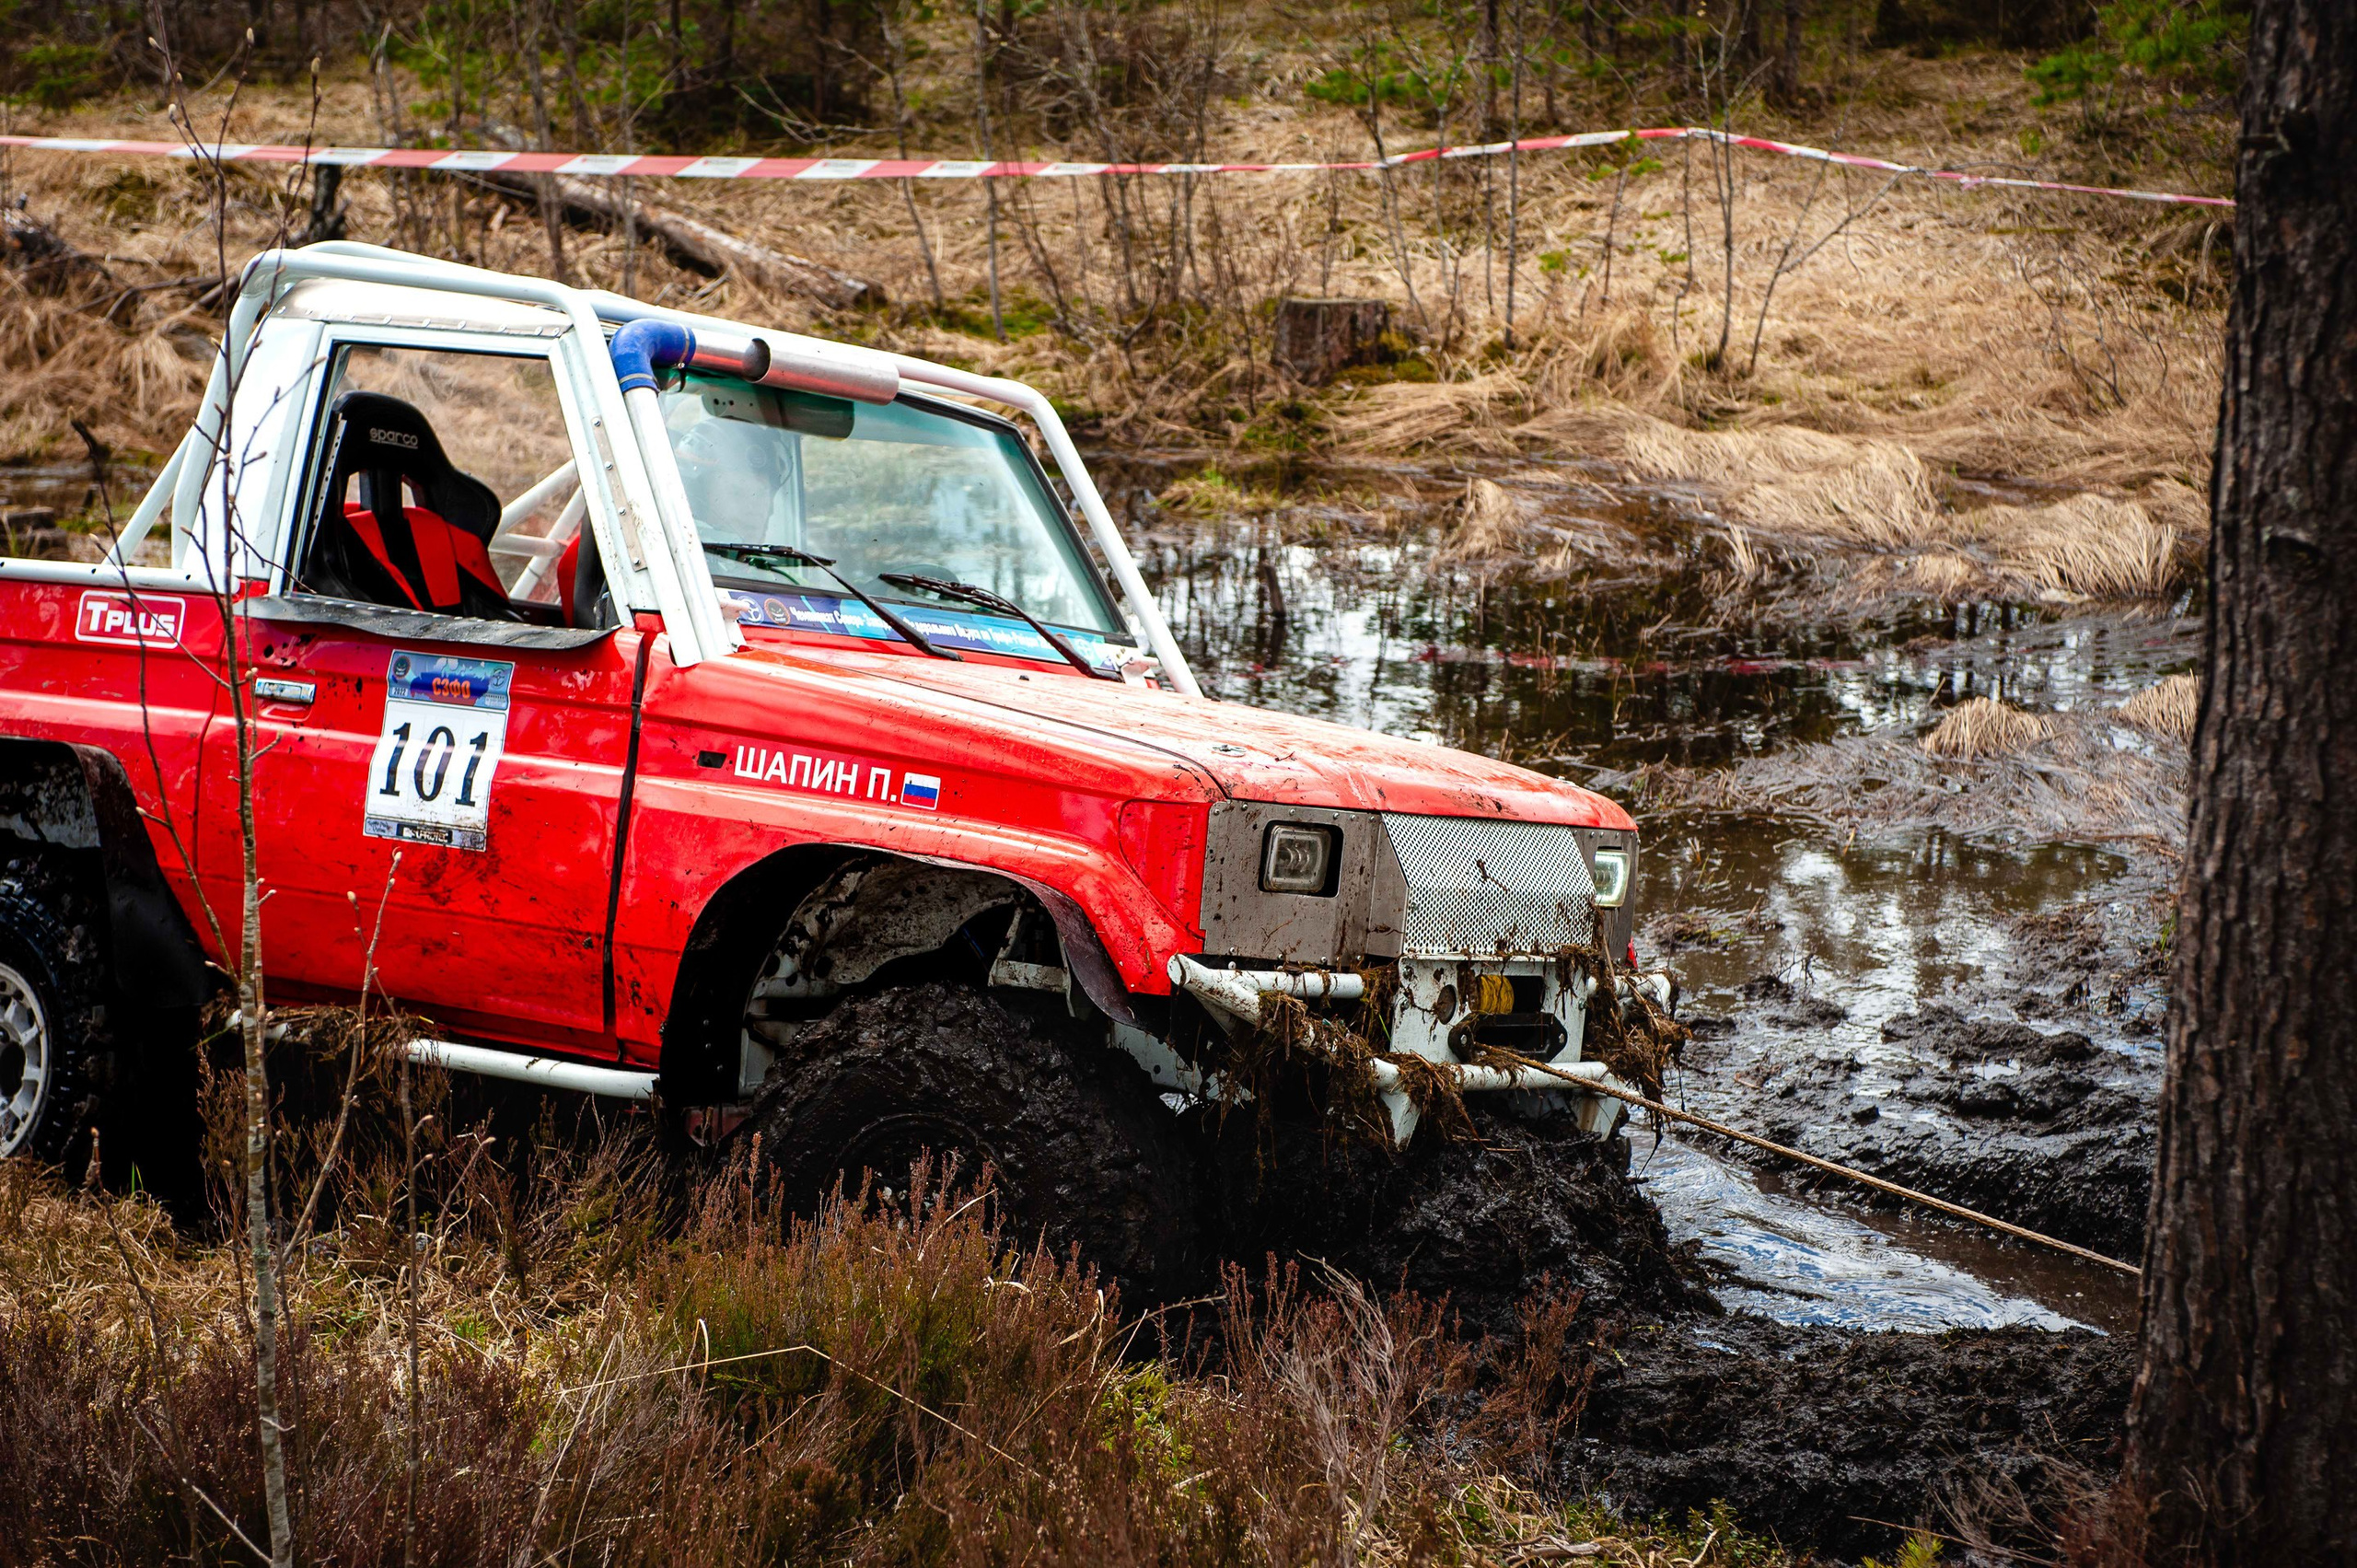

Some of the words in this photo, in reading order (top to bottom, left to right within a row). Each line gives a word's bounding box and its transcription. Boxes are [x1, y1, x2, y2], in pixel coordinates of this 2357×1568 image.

[369, 427, 418, 447] sparco
[432, 677, 470, 699] СЗФО
[379, 722, 488, 807] 101
[734, 745, 859, 796] ШАПИН
[866, 766, 897, 803] П.
